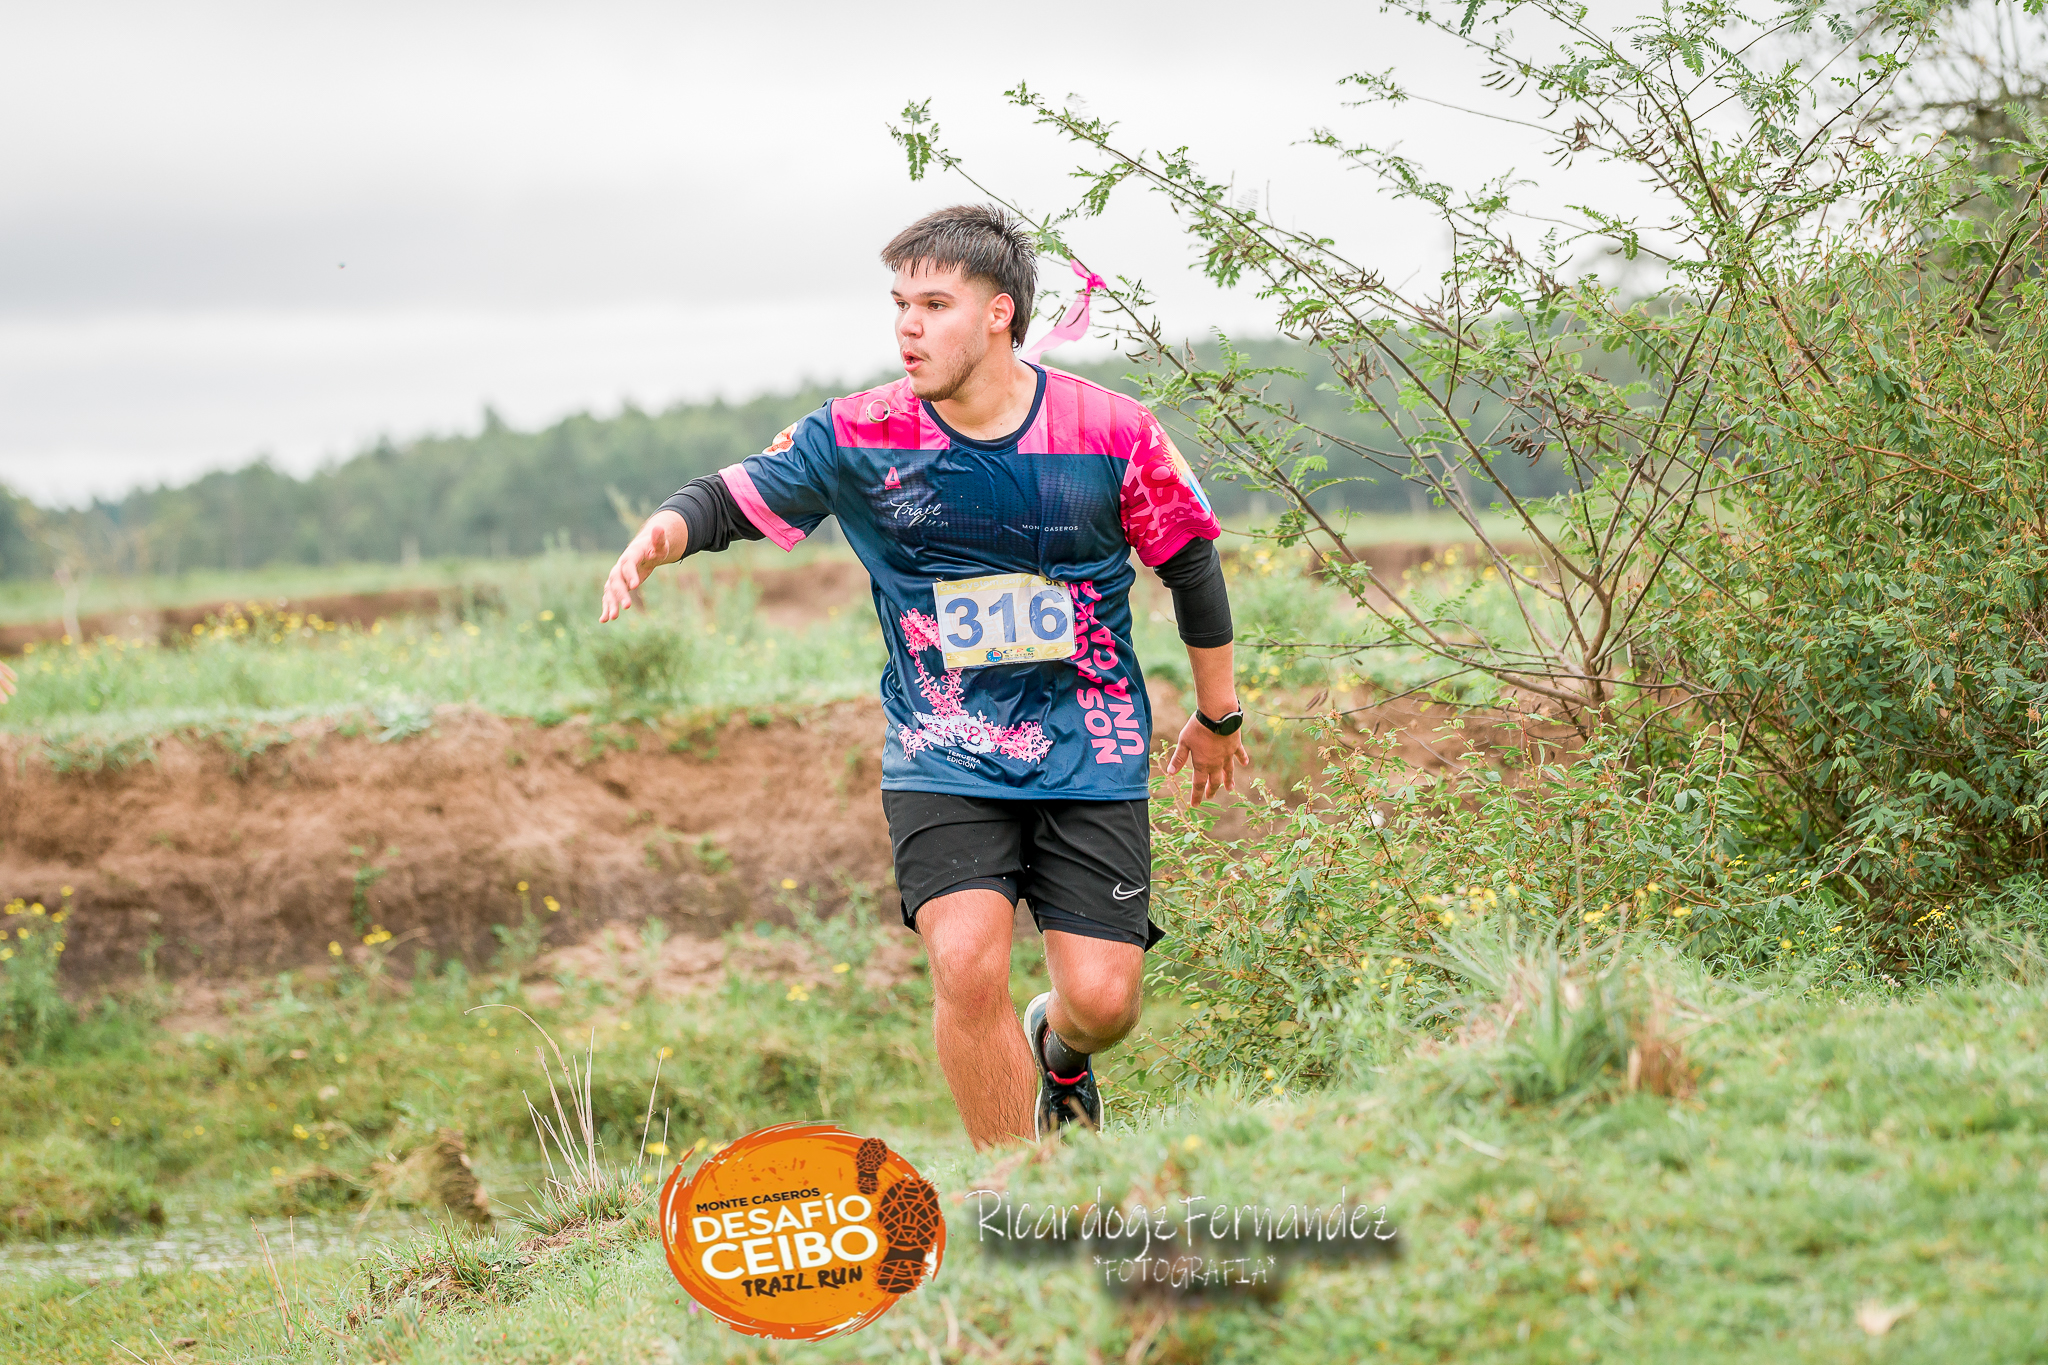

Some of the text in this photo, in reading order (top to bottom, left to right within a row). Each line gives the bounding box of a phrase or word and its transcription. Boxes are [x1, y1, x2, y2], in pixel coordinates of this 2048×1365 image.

[889, 500, 941, 519] Trail
[908, 515, 949, 528] Run
[940, 577, 1026, 592] crc-system.com
[945, 590, 1068, 648] 316
[1104, 676, 1145, 756] UNA
[1077, 687, 1123, 765] NOS
[946, 755, 976, 770] EDICIÓN
[948, 749, 981, 765] TERCERA
